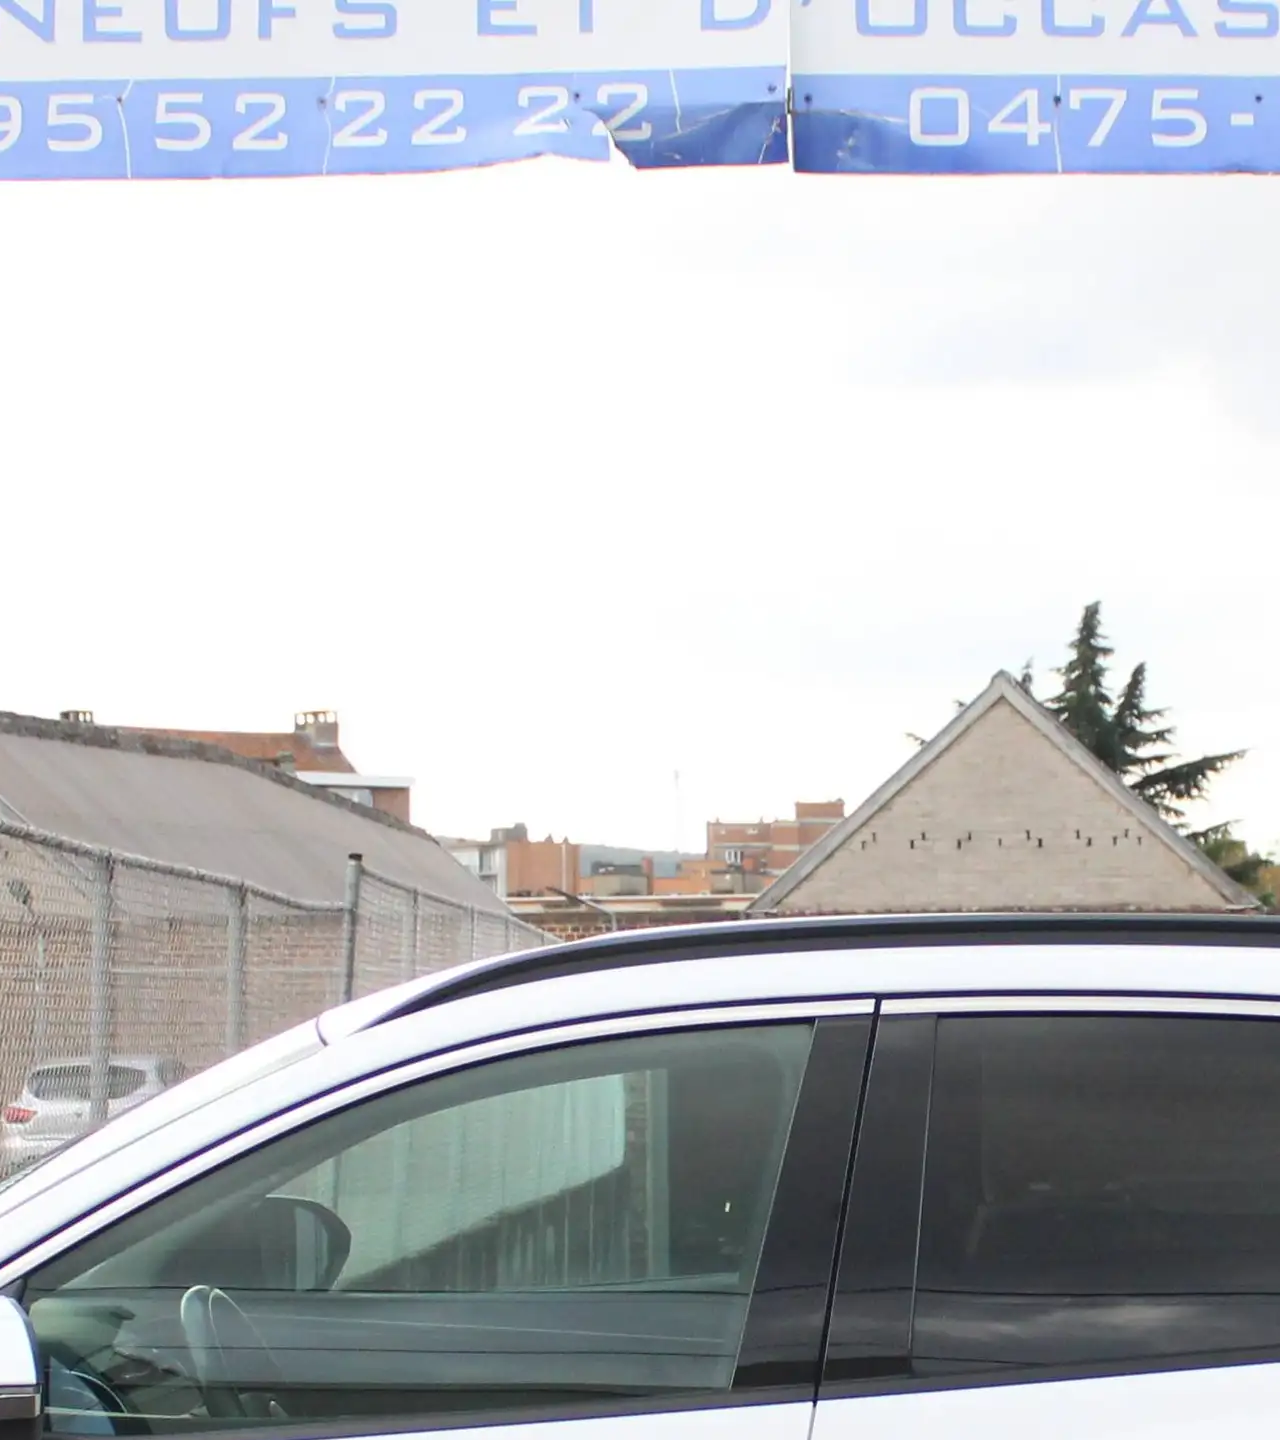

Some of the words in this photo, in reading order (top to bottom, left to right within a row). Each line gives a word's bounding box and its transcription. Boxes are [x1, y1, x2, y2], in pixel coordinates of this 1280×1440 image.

[155, 91, 288, 150] 52
[332, 88, 468, 147] 22
[512, 83, 652, 140] 22
